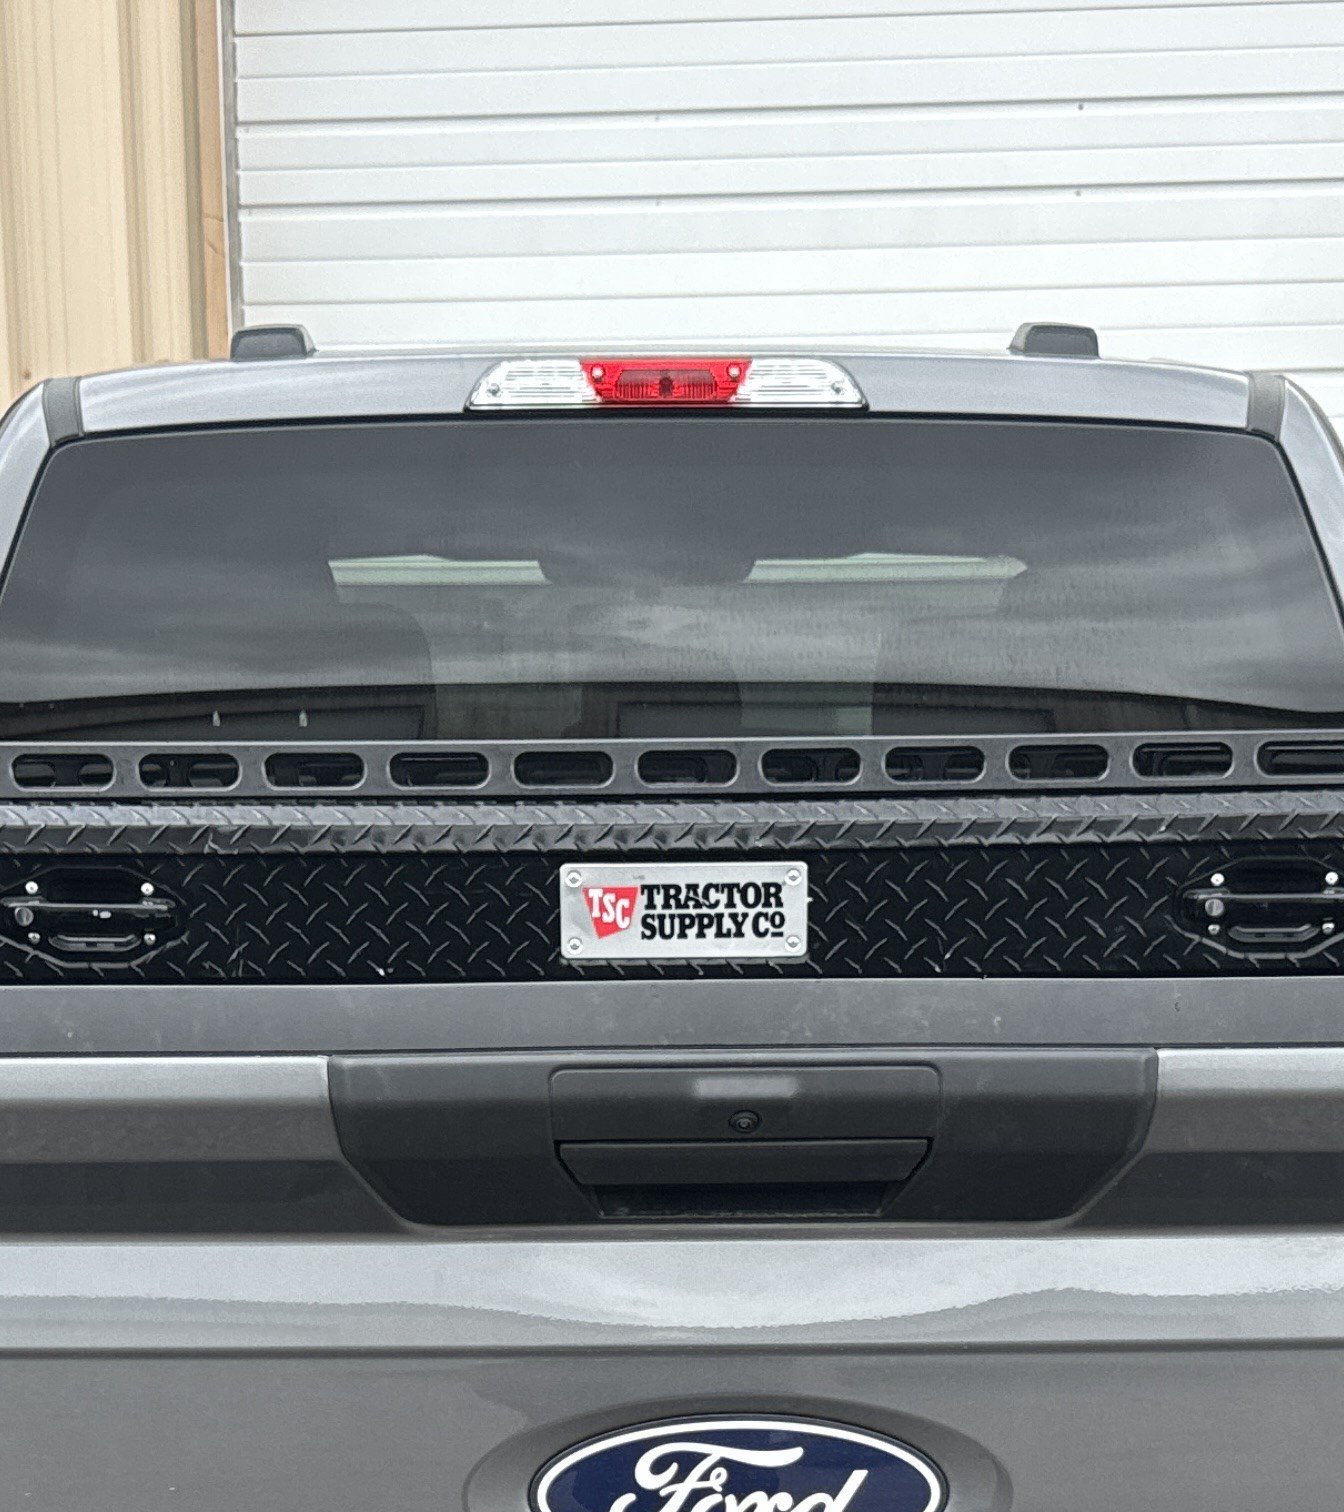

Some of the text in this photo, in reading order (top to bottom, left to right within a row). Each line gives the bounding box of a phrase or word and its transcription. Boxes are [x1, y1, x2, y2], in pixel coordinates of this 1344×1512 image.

[587, 887, 631, 930] TSC
[640, 882, 785, 911] TRACTOR
[640, 911, 749, 940] SUPPLY
